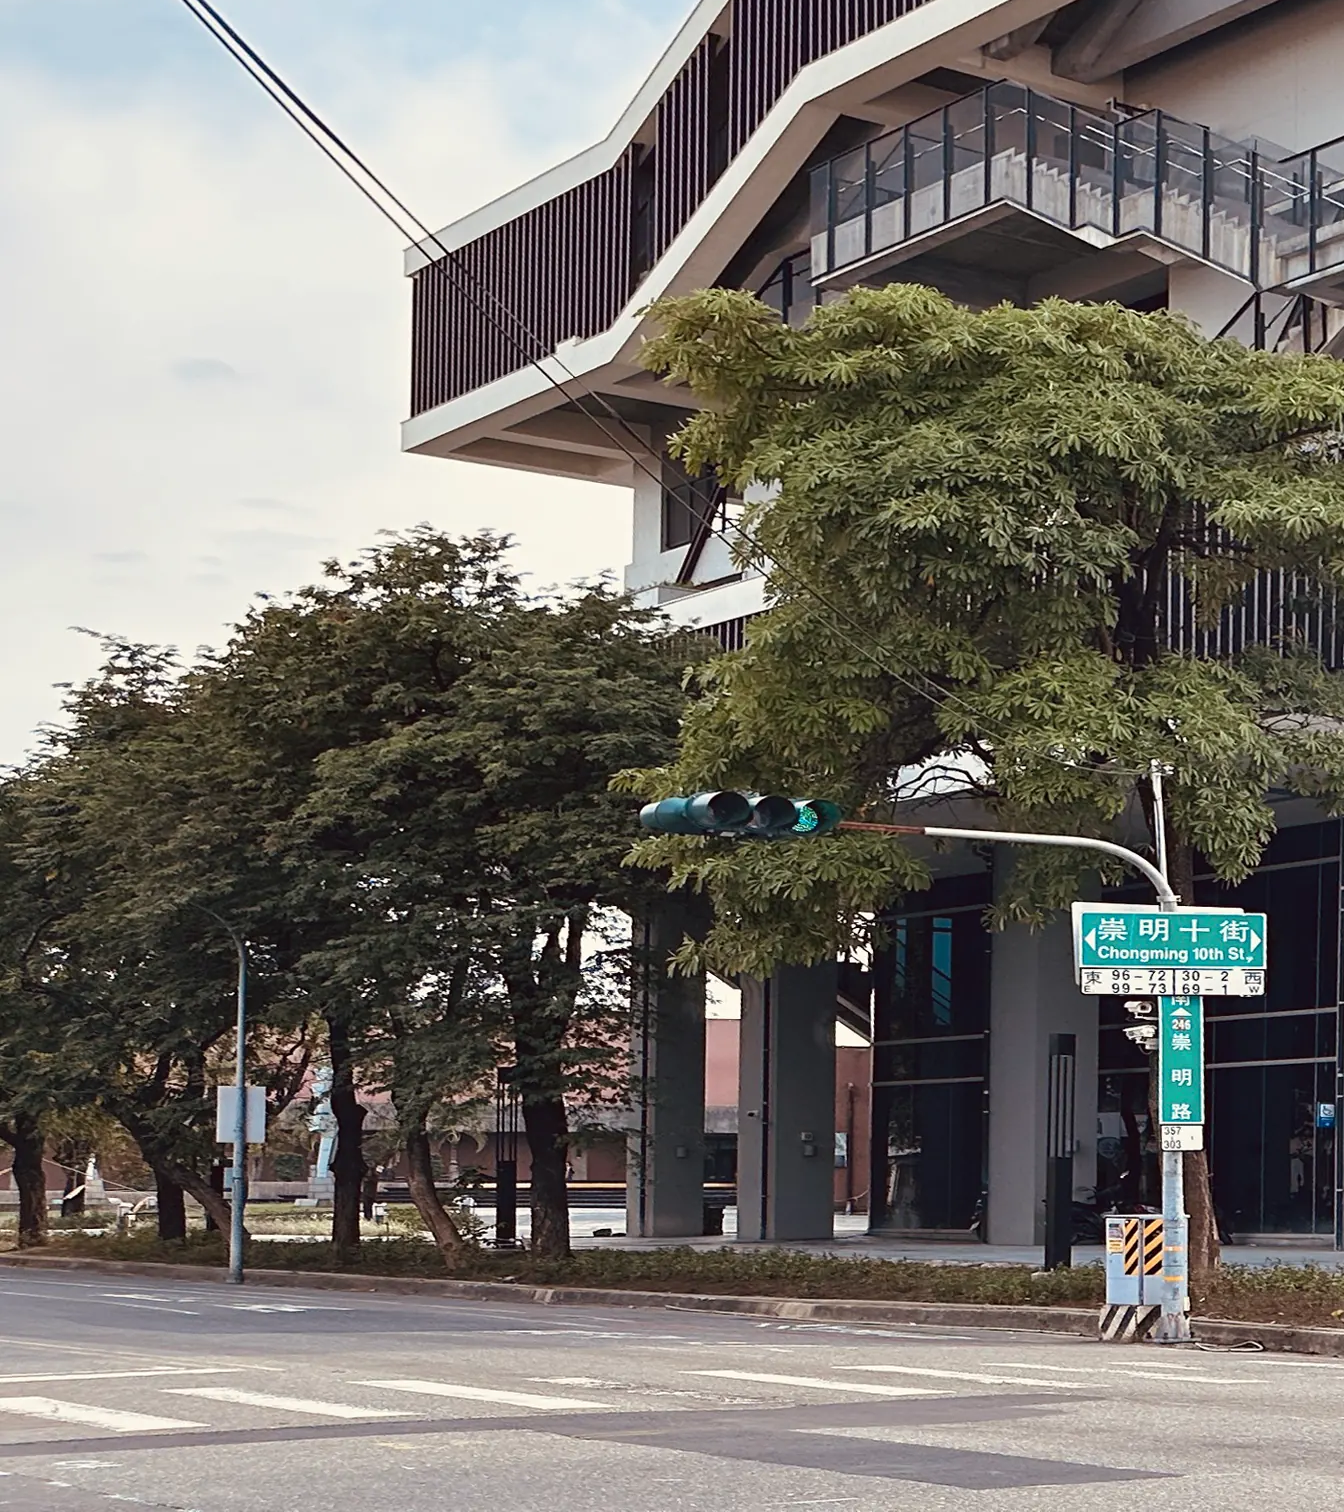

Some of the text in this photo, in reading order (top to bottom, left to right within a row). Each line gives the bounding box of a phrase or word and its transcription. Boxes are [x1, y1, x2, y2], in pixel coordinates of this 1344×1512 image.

[1098, 917, 1249, 942] 崇明十街
[1098, 946, 1188, 963] Chongming
[1192, 947, 1224, 960] 10th
[1084, 971, 1102, 985] 東
[1244, 972, 1262, 985] 西
[1171, 1018, 1192, 1031] 246
[1171, 1033, 1192, 1120] 崇明路
[1164, 1126, 1182, 1136] 357
[1164, 1140, 1182, 1149] 303
